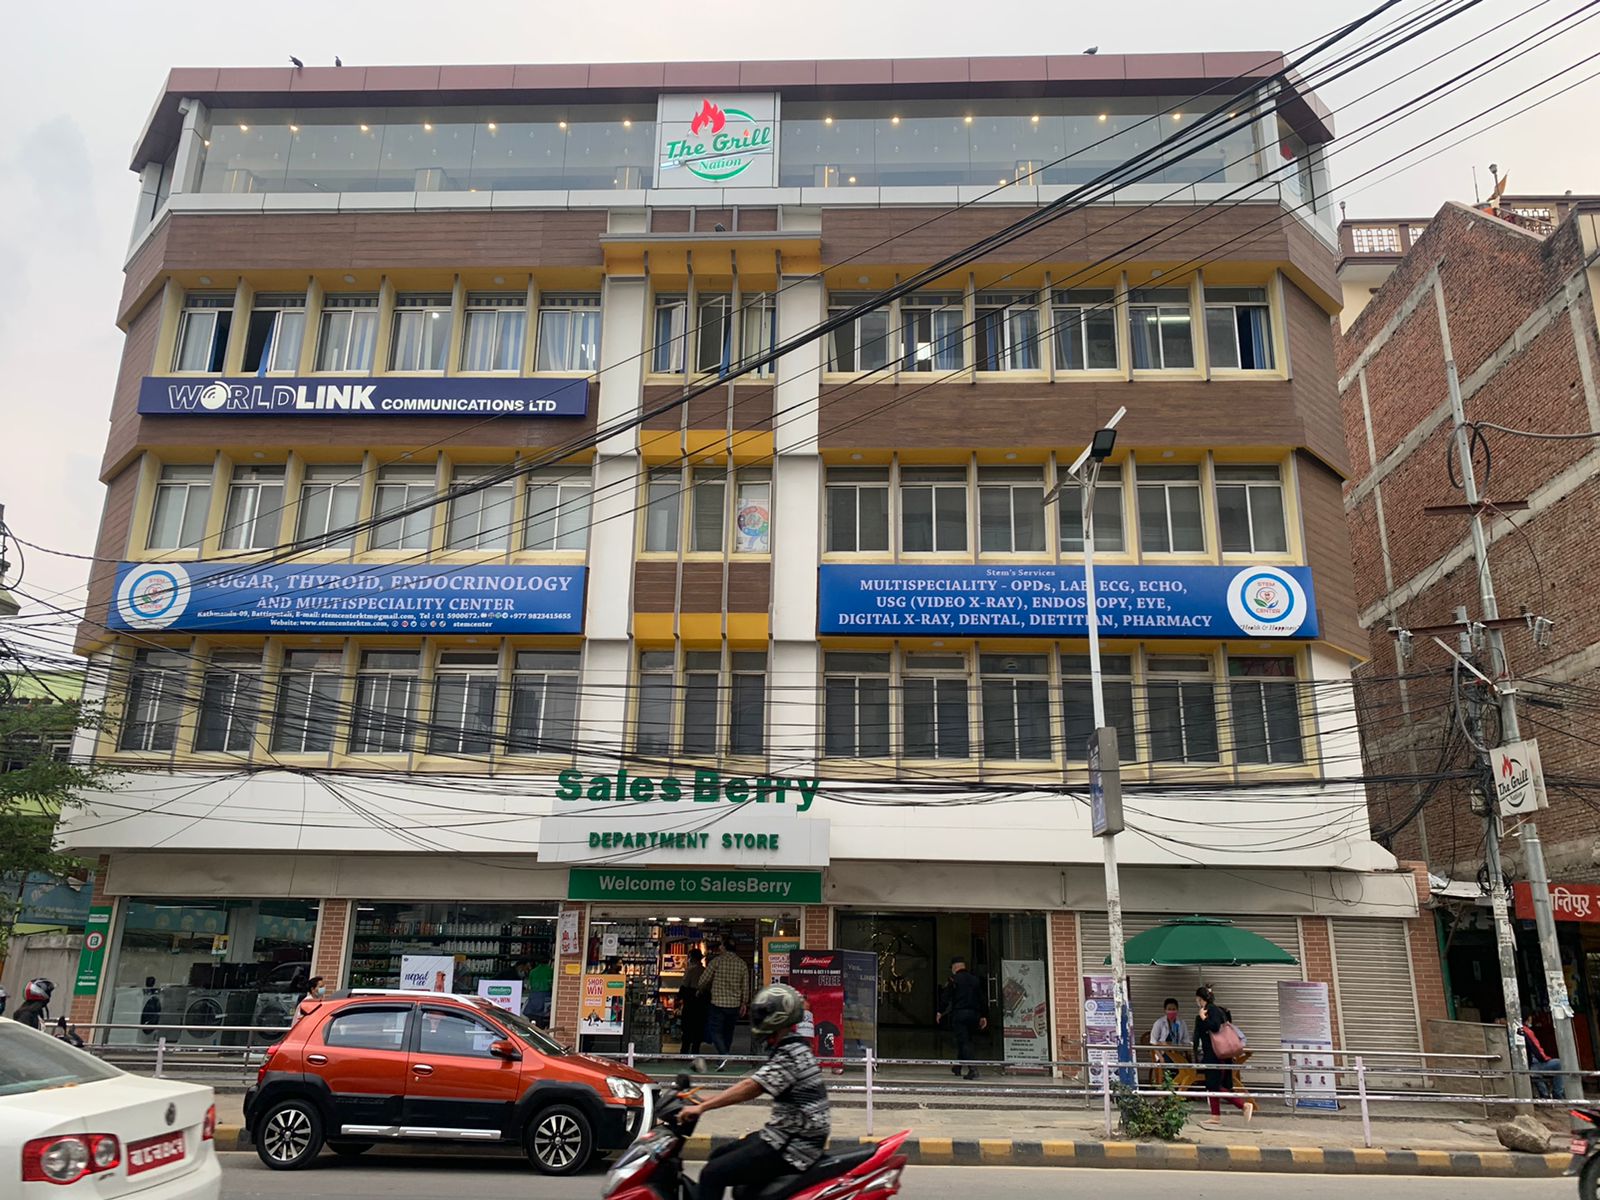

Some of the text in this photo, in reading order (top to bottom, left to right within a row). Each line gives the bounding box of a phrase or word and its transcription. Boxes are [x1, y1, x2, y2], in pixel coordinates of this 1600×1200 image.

[666, 127, 771, 159] The Grill
[700, 158, 742, 171] Nation
[381, 398, 524, 412] COMMUNICATIONS
[528, 399, 557, 412] LTD
[1017, 569, 1056, 577] Services
[206, 574, 573, 592] SUGAR, THYROID, ENDOCRINOLOGY
[860, 580, 997, 591] MULTISPECIALITY
[1011, 580, 1056, 593] OPDs,
[1099, 580, 1135, 594] ECG,
[1138, 580, 1187, 594] ECHO,
[256, 596, 515, 611] AND MULTISPECIALITY CENTER
[876, 596, 1171, 611] USG (VIDEO X-RAY), ENDOSOPY, EYE,
[838, 613, 901, 625] DIGITAL
[903, 614, 955, 627] X-RAY,
[958, 614, 1025, 628] DENTAL,
[1123, 615, 1213, 627] PHARMACY
[1498, 782, 1511, 796] The
[1511, 768, 1529, 789] Grill
[588, 832, 779, 850] DEPARTMENT STORE
[599, 876, 792, 897] Welcome to SalesBerry
[802, 956, 832, 964] Budweiser
[404, 970, 430, 985] nepal
[818, 975, 841, 986] FREE
[587, 986, 603, 995] WIN
